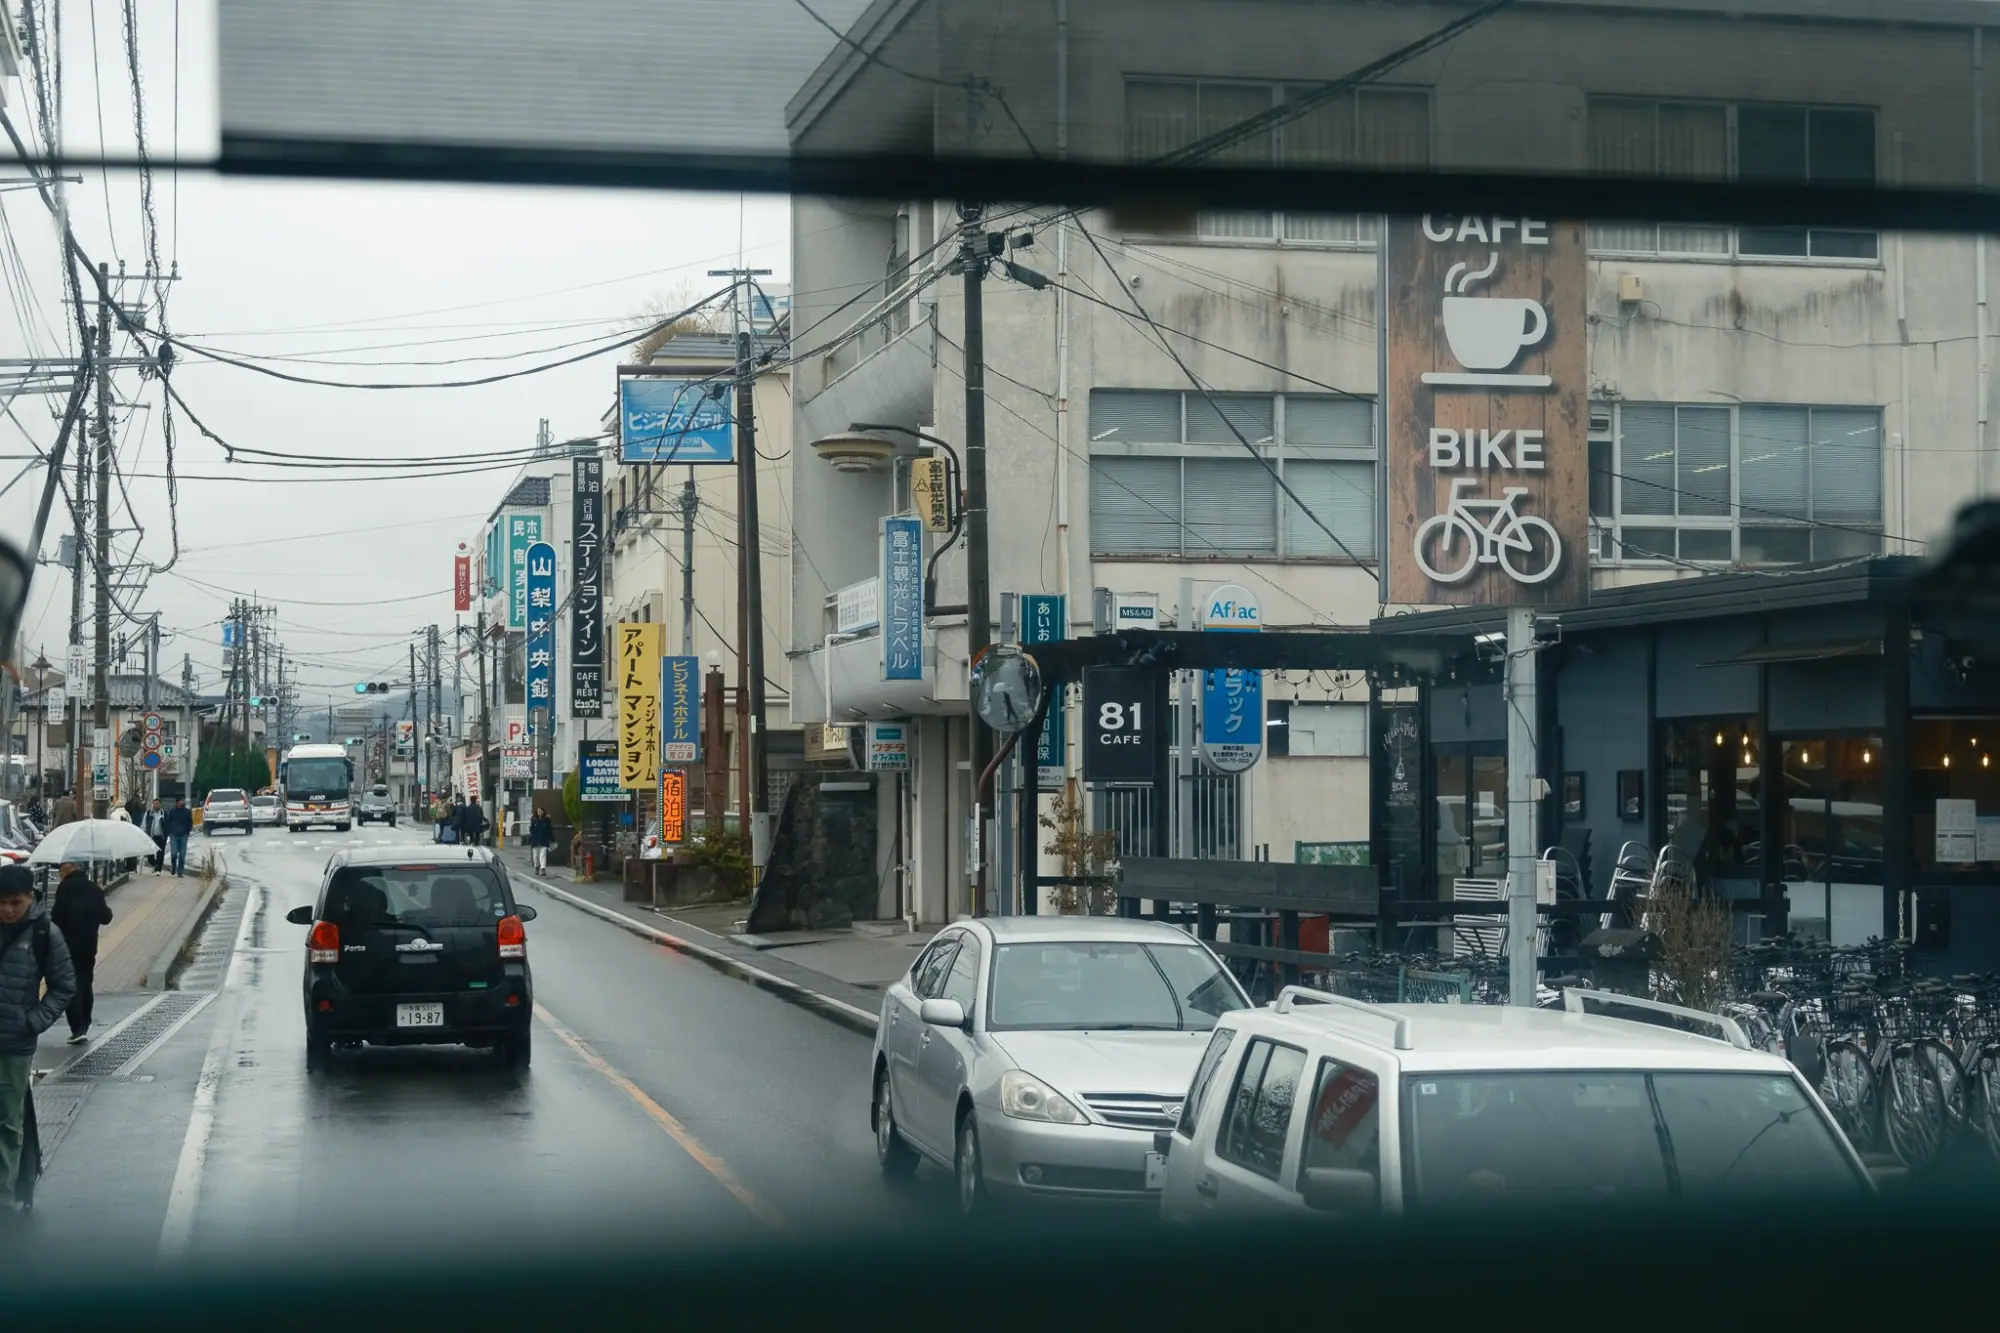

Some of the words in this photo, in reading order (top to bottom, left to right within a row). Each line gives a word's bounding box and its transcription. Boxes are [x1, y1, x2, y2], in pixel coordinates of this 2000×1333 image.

[1422, 213, 1548, 245] CAFE
[628, 411, 726, 431] ビジネスホテル
[1429, 427, 1545, 469] BIKE
[588, 462, 599, 492] 宿泊
[929, 460, 945, 527] 富士観光開発
[513, 520, 525, 565] 民宿
[527, 520, 538, 544] ホテ
[892, 530, 909, 669] 富士観光トラベル
[1122, 608, 1152, 617] MS&AD
[1210, 601, 1256, 619] Aflac
[531, 556, 553, 699] 山梨中央銀
[624, 629, 644, 690] アパート
[576, 672, 599, 681] CAFE
[584, 681, 591, 689] &
[576, 688, 599, 697] REST
[672, 660, 688, 740] ビジネスホテル
[509, 722, 521, 740] P
[1099, 702, 1142, 731] 81
[624, 695, 643, 782] マンション
[645, 696, 656, 782] フジオホーム
[1100, 734, 1141, 745] CAFE
[586, 759, 619, 767] LODGIN
[586, 776, 619, 784] SHOWE
[663, 775, 682, 839] 宿泊所
